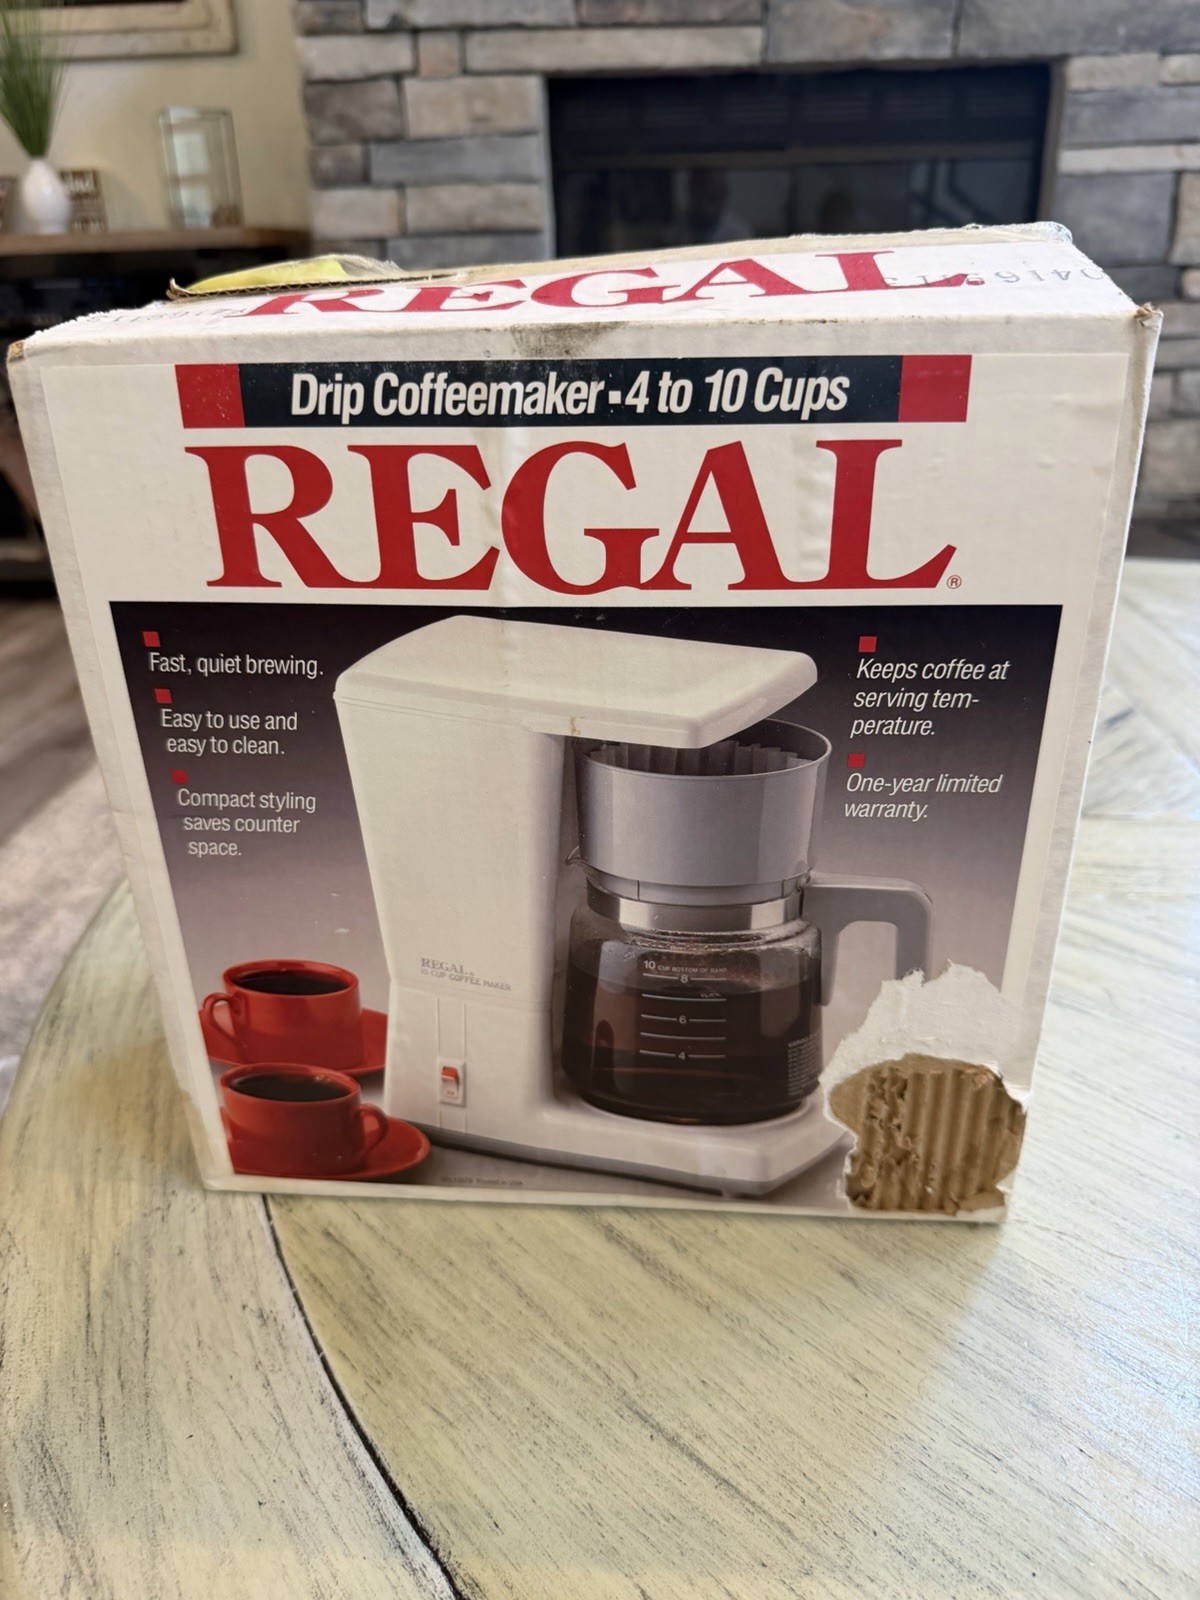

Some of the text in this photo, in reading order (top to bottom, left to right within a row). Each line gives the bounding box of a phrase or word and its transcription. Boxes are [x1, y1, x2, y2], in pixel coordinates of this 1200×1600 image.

[225, 249, 970, 319] REGAL
[291, 366, 850, 425] Drip Coffeemaker 4 to 10 Cups
[184, 438, 958, 596] REGAL
[149, 651, 324, 679] Fast, quiet brewing.
[857, 658, 1011, 683] Keeps coffee at
[853, 688, 980, 712] serving tem-
[161, 708, 298, 732] Easy to use and
[850, 716, 936, 739] perature.
[167, 736, 286, 757] easy to clean.
[846, 772, 1004, 796] One-year limited
[178, 788, 317, 814] Compact styling
[844, 801, 929, 822] warranty.
[184, 815, 301, 833] saves counter
[188, 840, 242, 858] space.
[421, 957, 468, 975] REGAL
[643, 960, 656, 970] 10
[430, 970, 447, 979] CUP
[449, 974, 481, 986] COFFEE
[483, 980, 512, 991] MAKER
[680, 974, 688, 984] 8
[679, 1015, 687, 1025] 6
[678, 1051, 686, 1060] 4
